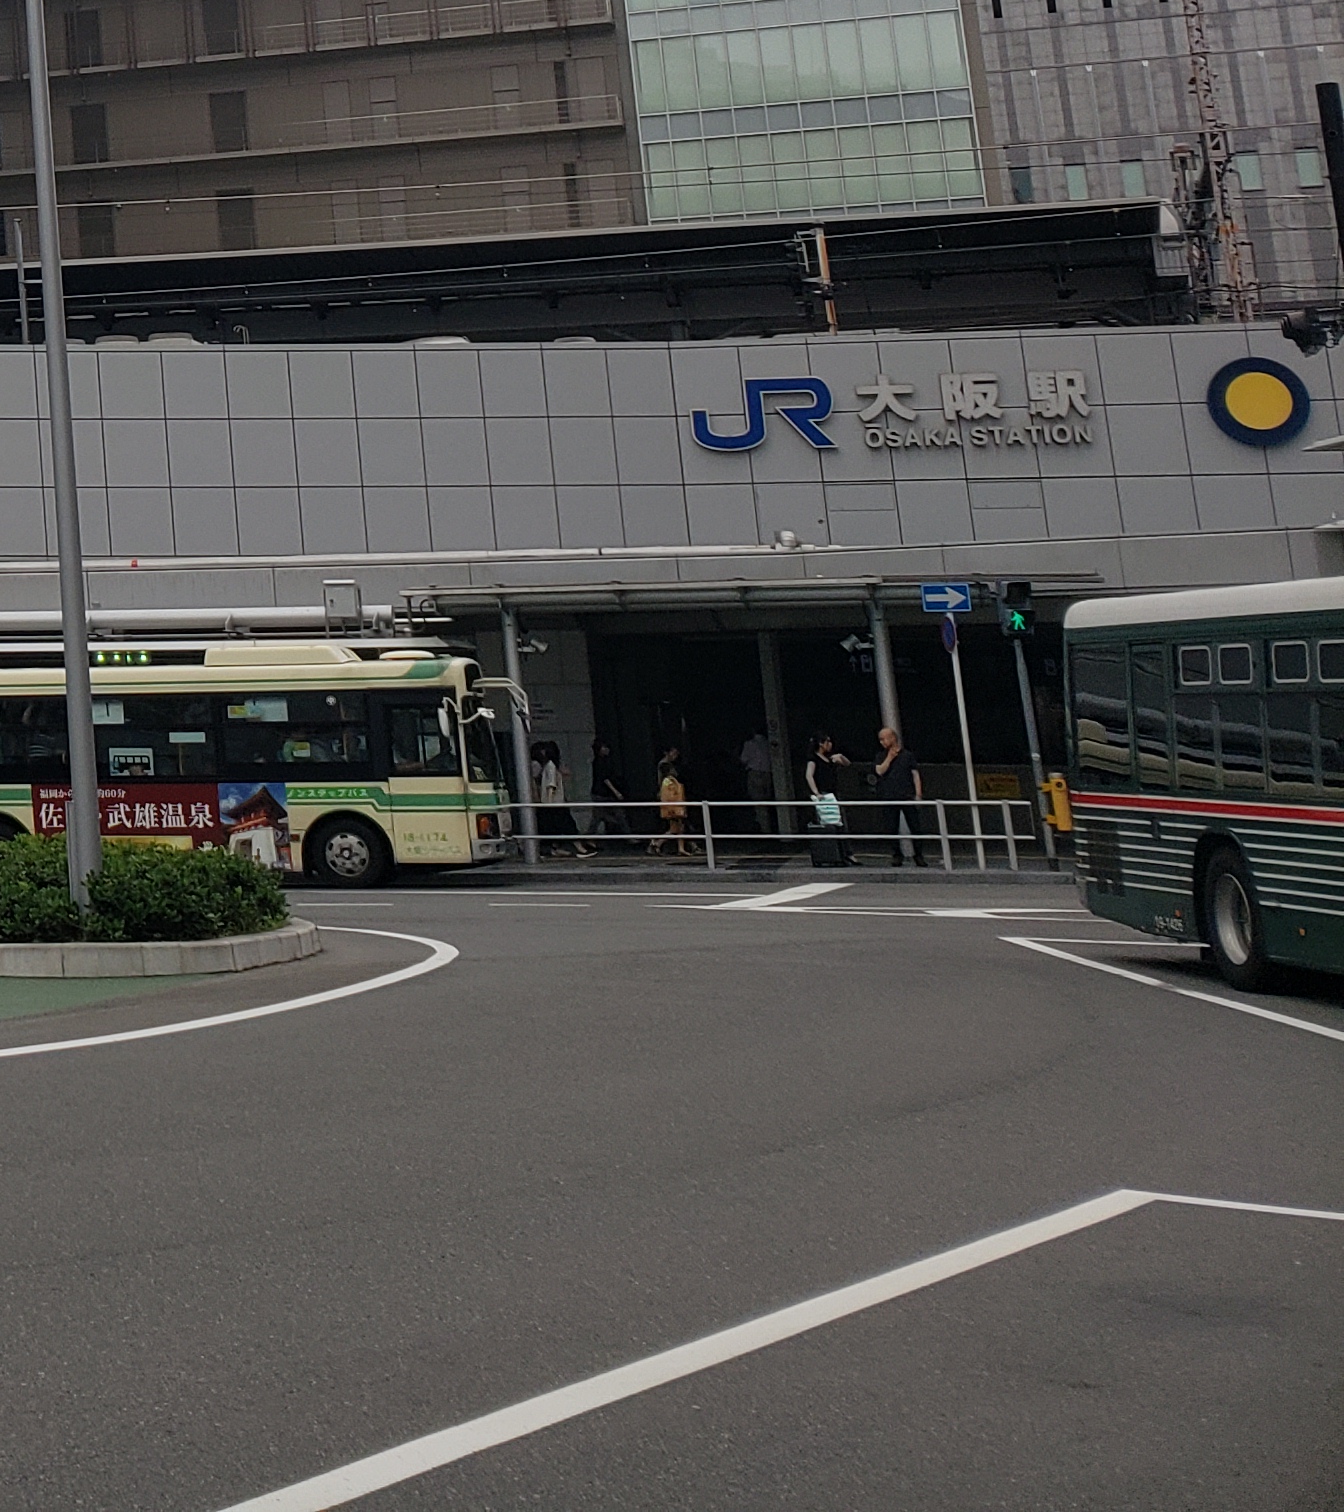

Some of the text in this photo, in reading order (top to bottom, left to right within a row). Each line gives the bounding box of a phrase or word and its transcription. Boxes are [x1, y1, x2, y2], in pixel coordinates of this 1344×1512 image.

[689, 375, 839, 451] JR
[856, 370, 1092, 422] 大阪駅
[970, 423, 1094, 447] STATION
[39, 801, 216, 830] 佐・武雄温泉
